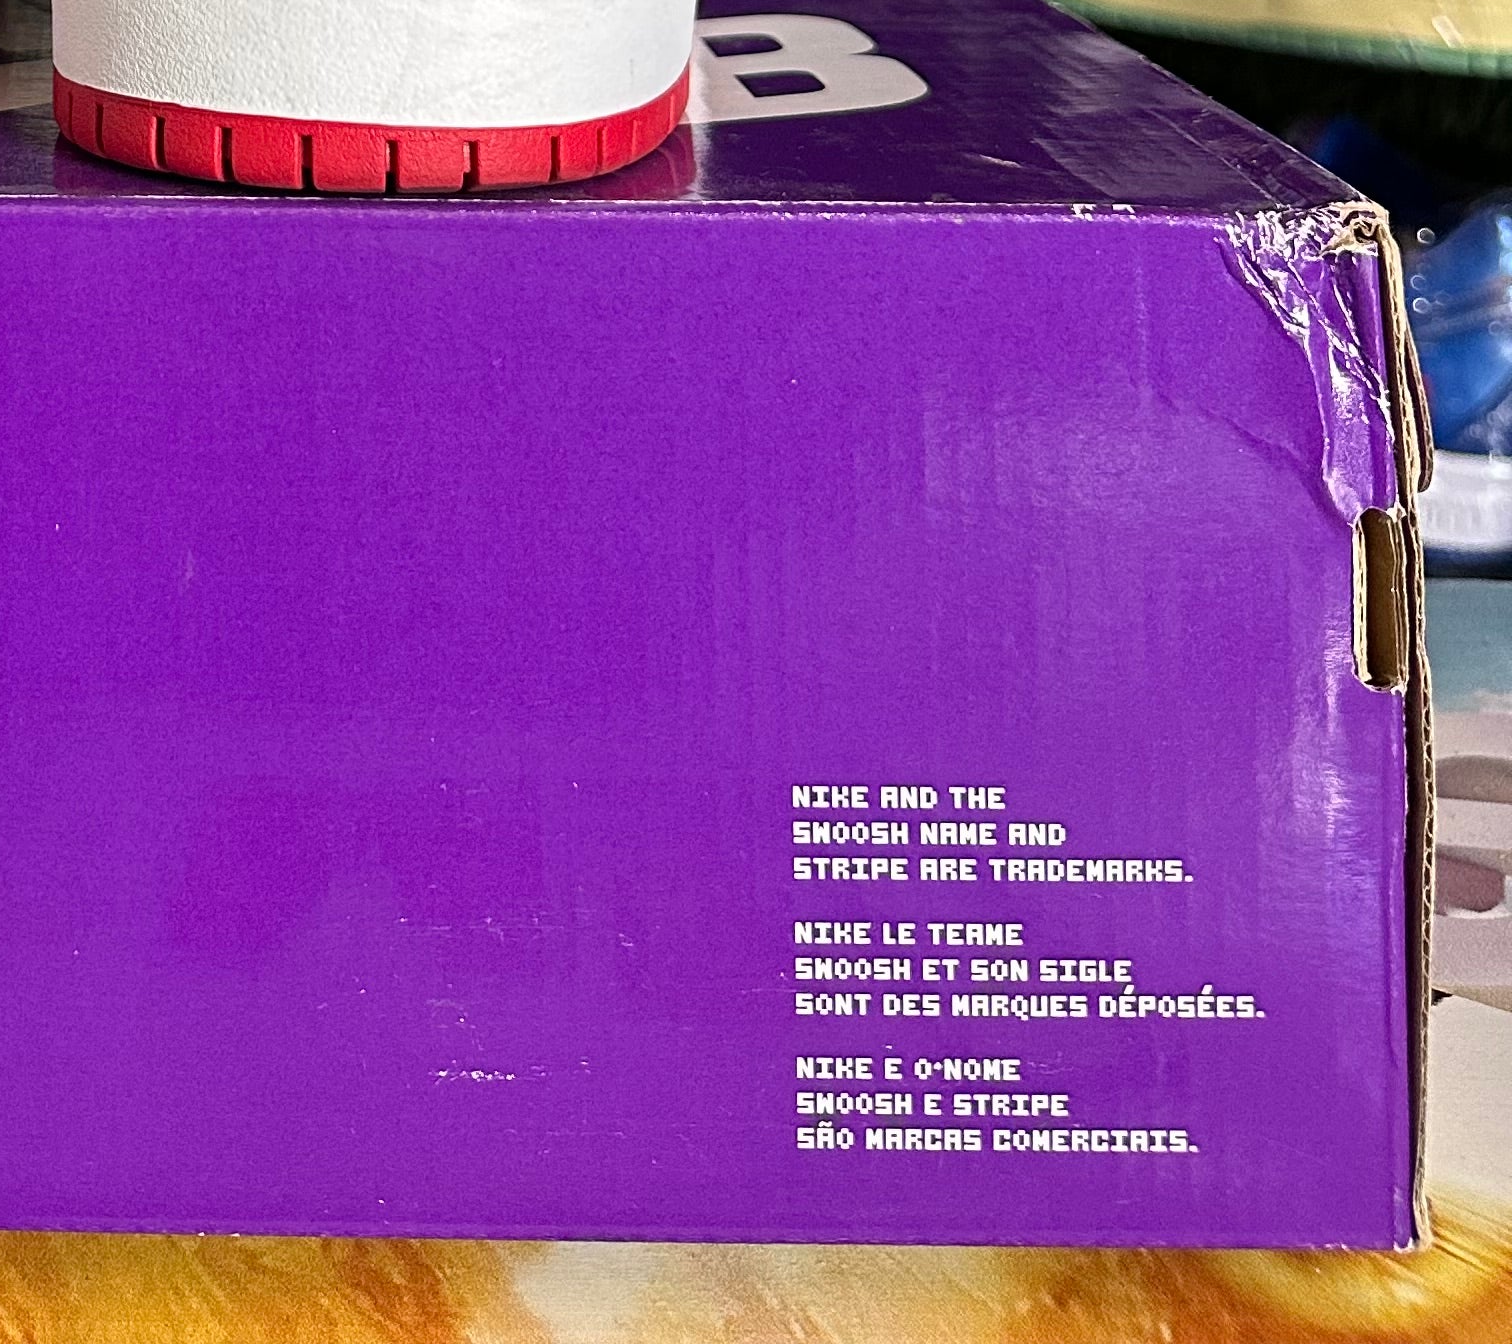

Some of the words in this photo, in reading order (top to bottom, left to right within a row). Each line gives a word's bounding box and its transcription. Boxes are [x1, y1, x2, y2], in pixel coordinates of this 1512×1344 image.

[793, 785, 869, 809] NIKE
[881, 786, 938, 809] AND
[949, 786, 1006, 810] THE
[793, 821, 909, 845] SWOOSH
[920, 822, 997, 846] NAME
[1009, 823, 1067, 846] AND
[793, 857, 909, 881] STRIPE
[920, 858, 978, 881] ARE
[989, 858, 1194, 883] TRADEMARKS.
[794, 921, 872, 945] NIKE
[882, 922, 916, 945] LE
[795, 957, 911, 981] SWOOSH
[922, 958, 960, 981] ET
[971, 959, 1029, 982] SON
[1039, 959, 1133, 983] SIGLE
[795, 992, 872, 1016] SONT
[882, 993, 941, 1017] DES
[951, 994, 1088, 1022] MARQUES
[1098, 984, 1266, 1019] DÉPOSÉES.
[796, 1056, 873, 1080] NIKE
[884, 1057, 903, 1080] E
[796, 1092, 913, 1116] SWOOSH
[923, 1093, 942, 1116] E
[953, 1093, 1069, 1117] STRIPE
[796, 1121, 854, 1150] SÃO
[865, 1128, 982, 1151] MARCAS
[992, 1129, 1199, 1153] COMERCIAIS.
